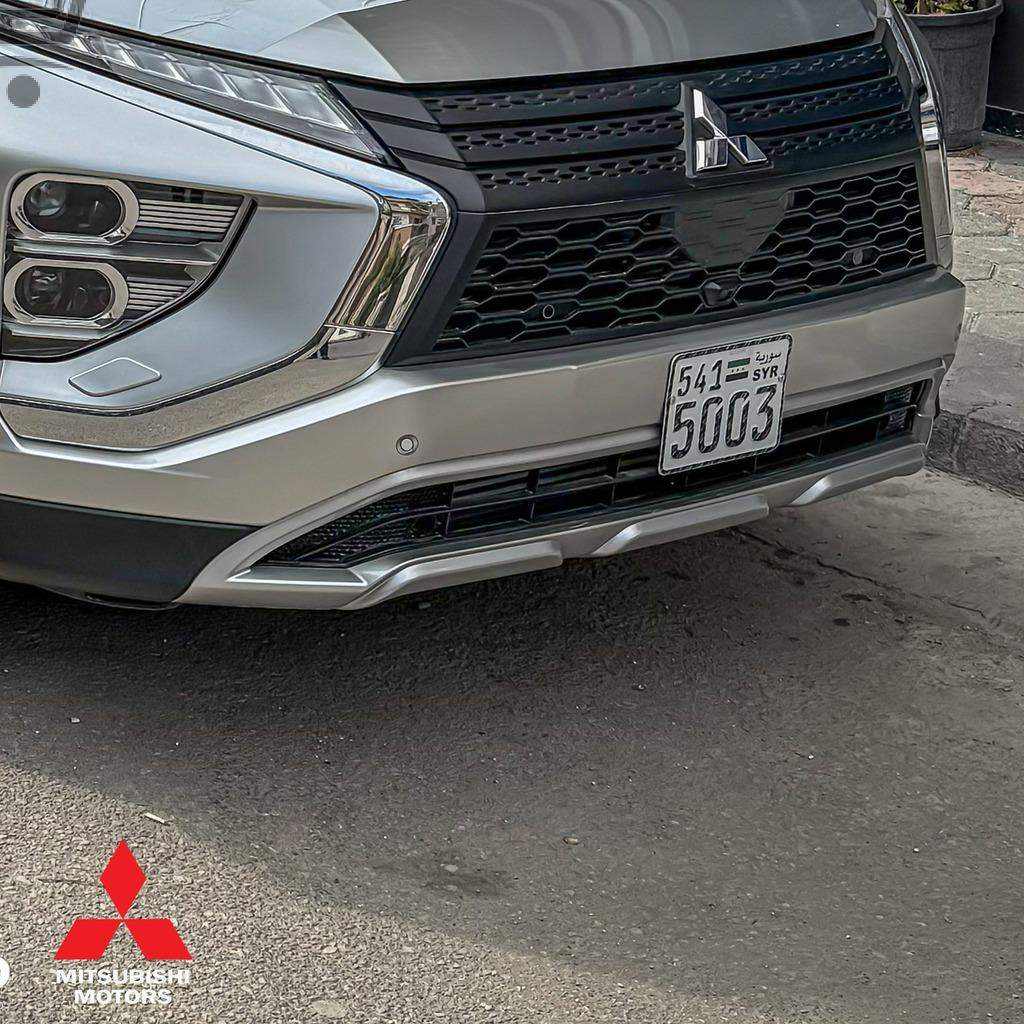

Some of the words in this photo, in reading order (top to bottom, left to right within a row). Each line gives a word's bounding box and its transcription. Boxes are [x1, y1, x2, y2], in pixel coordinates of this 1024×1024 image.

[755, 351, 782, 365] سورية
[677, 359, 723, 397] 541
[752, 365, 779, 381] SYR
[670, 384, 778, 460] 5003
